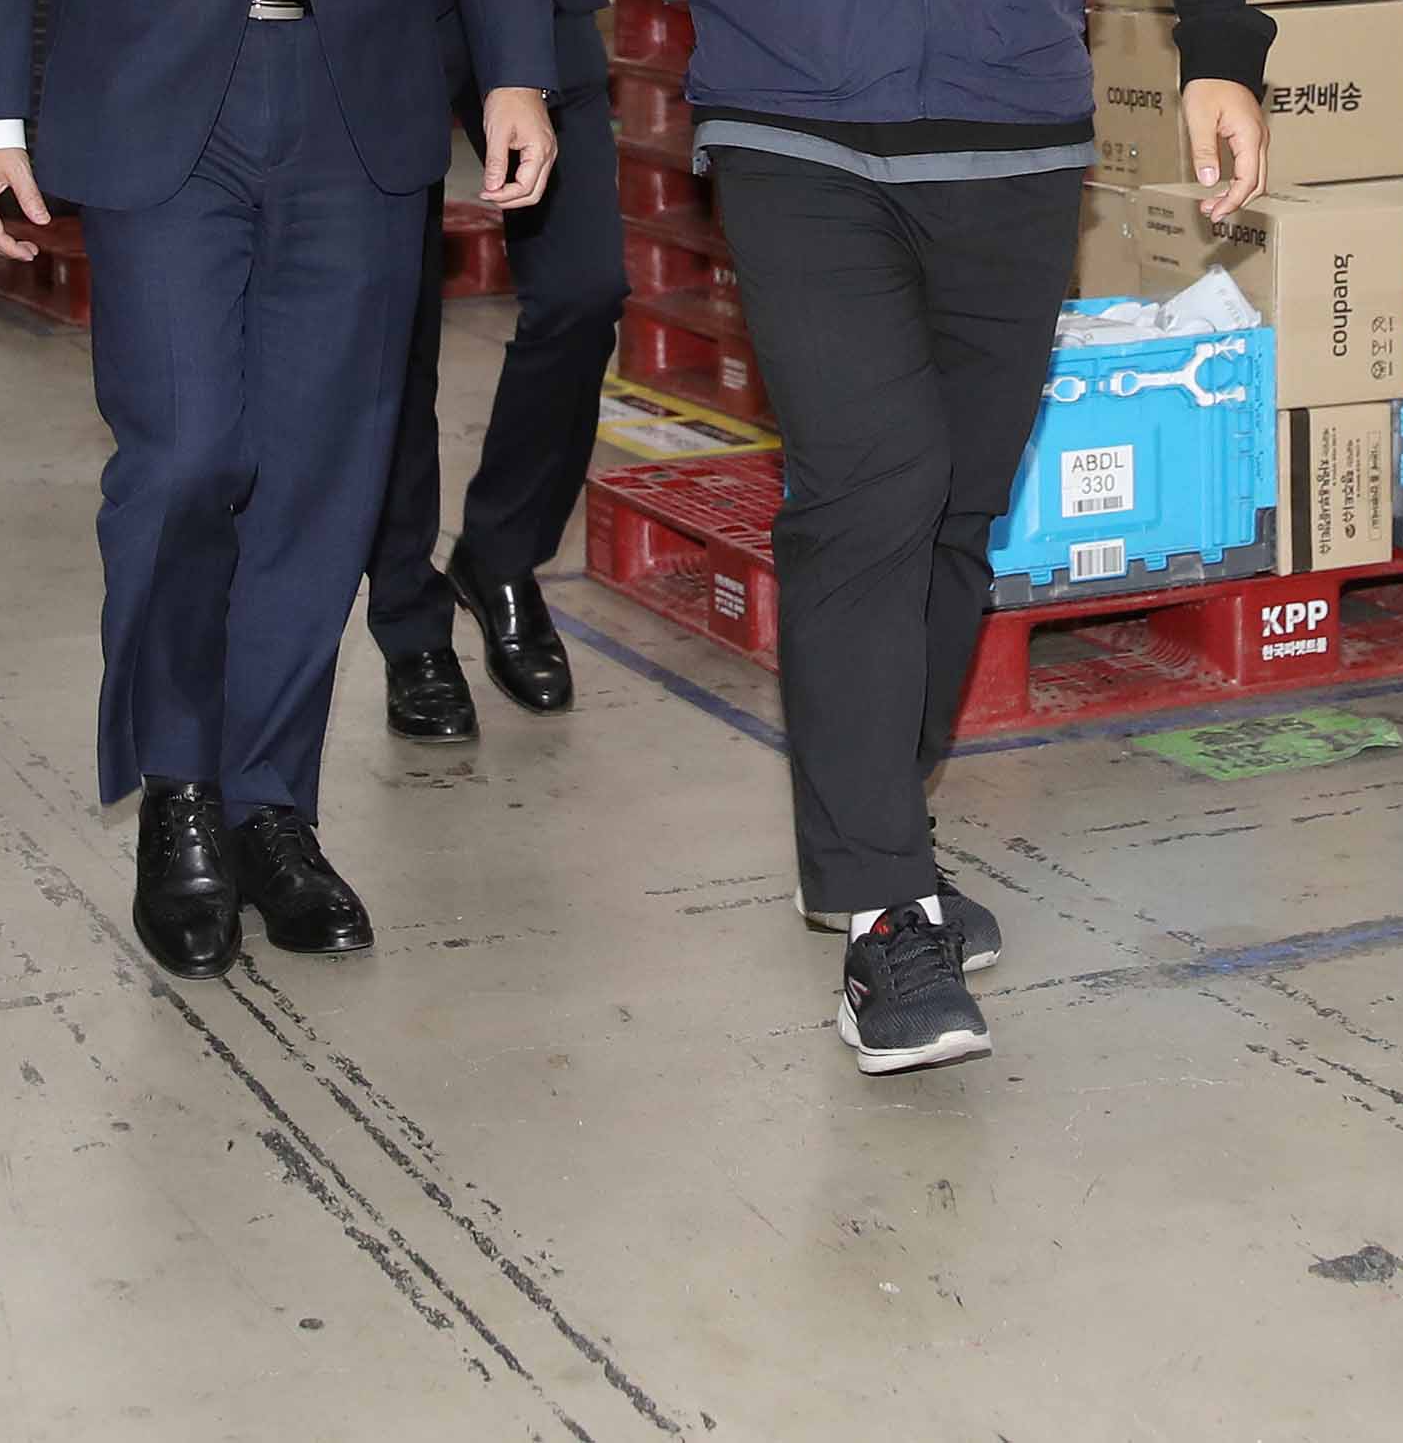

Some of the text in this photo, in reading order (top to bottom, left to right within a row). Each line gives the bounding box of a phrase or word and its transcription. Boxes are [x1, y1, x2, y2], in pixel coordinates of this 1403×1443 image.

[1107, 87, 1163, 116] coupang
[1269, 82, 1362, 115] 로켓배송
[1212, 221, 1267, 254] coupang
[1333, 254, 1354, 357] coupang
[1072, 452, 1126, 472] ABDL
[1082, 473, 1115, 495] 330
[1262, 599, 1329, 638] KPP
